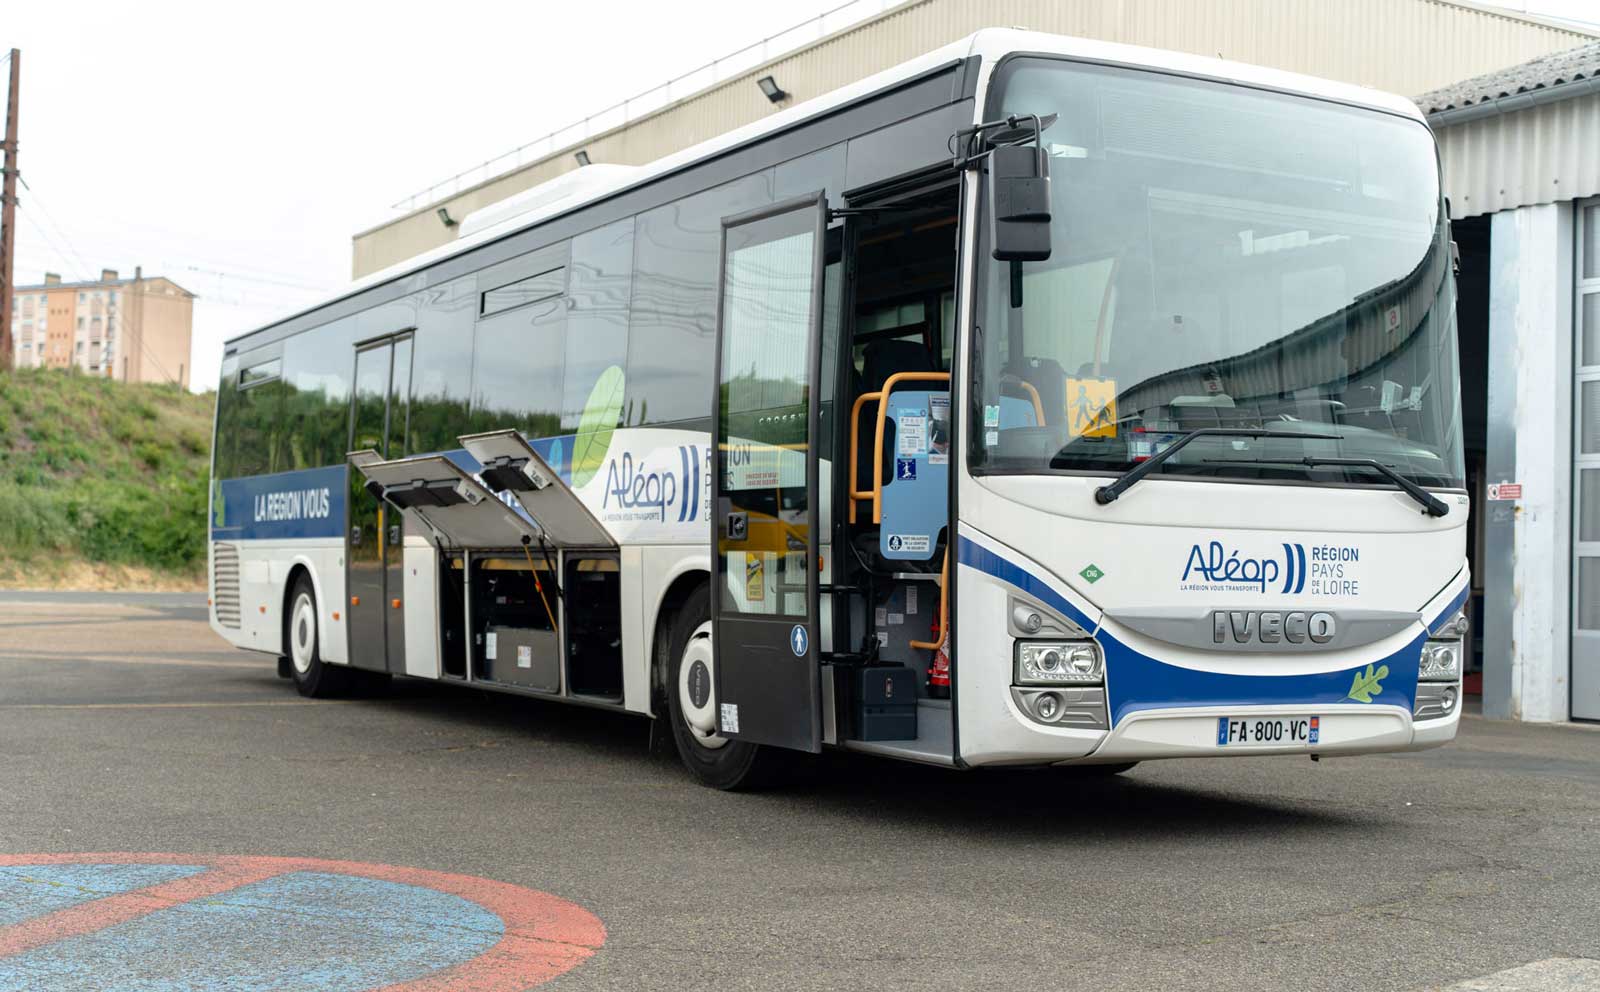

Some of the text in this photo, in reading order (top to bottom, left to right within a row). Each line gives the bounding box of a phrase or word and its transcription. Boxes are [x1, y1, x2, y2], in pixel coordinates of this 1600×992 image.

[602, 451, 676, 523] Aléop
[254, 487, 330, 522] LA REGION VOUS
[1312, 544, 1359, 562] RÉGION
[1181, 541, 1280, 594] Aléop
[1311, 563, 1344, 578] PAYS
[1323, 580, 1359, 595] LOIRE
[1212, 610, 1337, 644] IVECO
[1228, 720, 1308, 742] FA-800-VC
